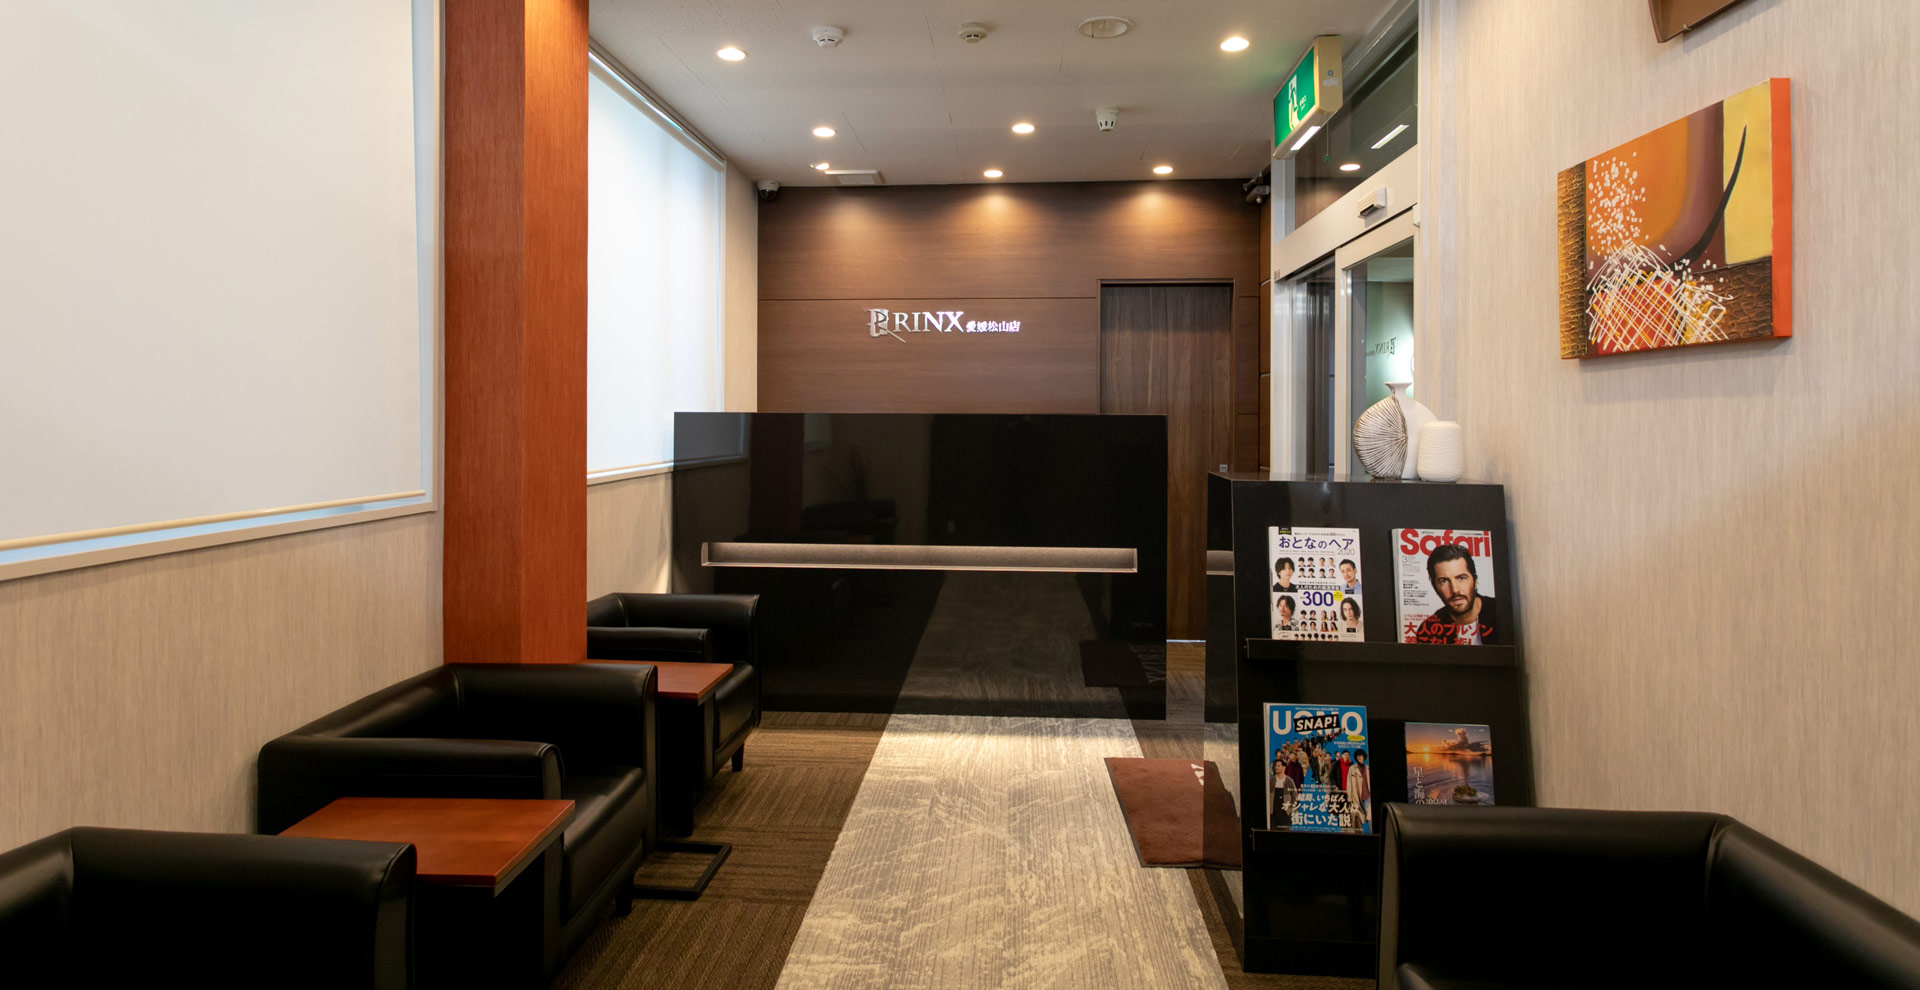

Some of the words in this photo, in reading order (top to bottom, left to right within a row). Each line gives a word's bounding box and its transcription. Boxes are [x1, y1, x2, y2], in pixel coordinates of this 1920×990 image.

[1279, 536, 1354, 550] おとなのヘア
[1400, 528, 1491, 557] Safari
[1302, 591, 1334, 606] 300
[1296, 716, 1337, 731] SNAP!
